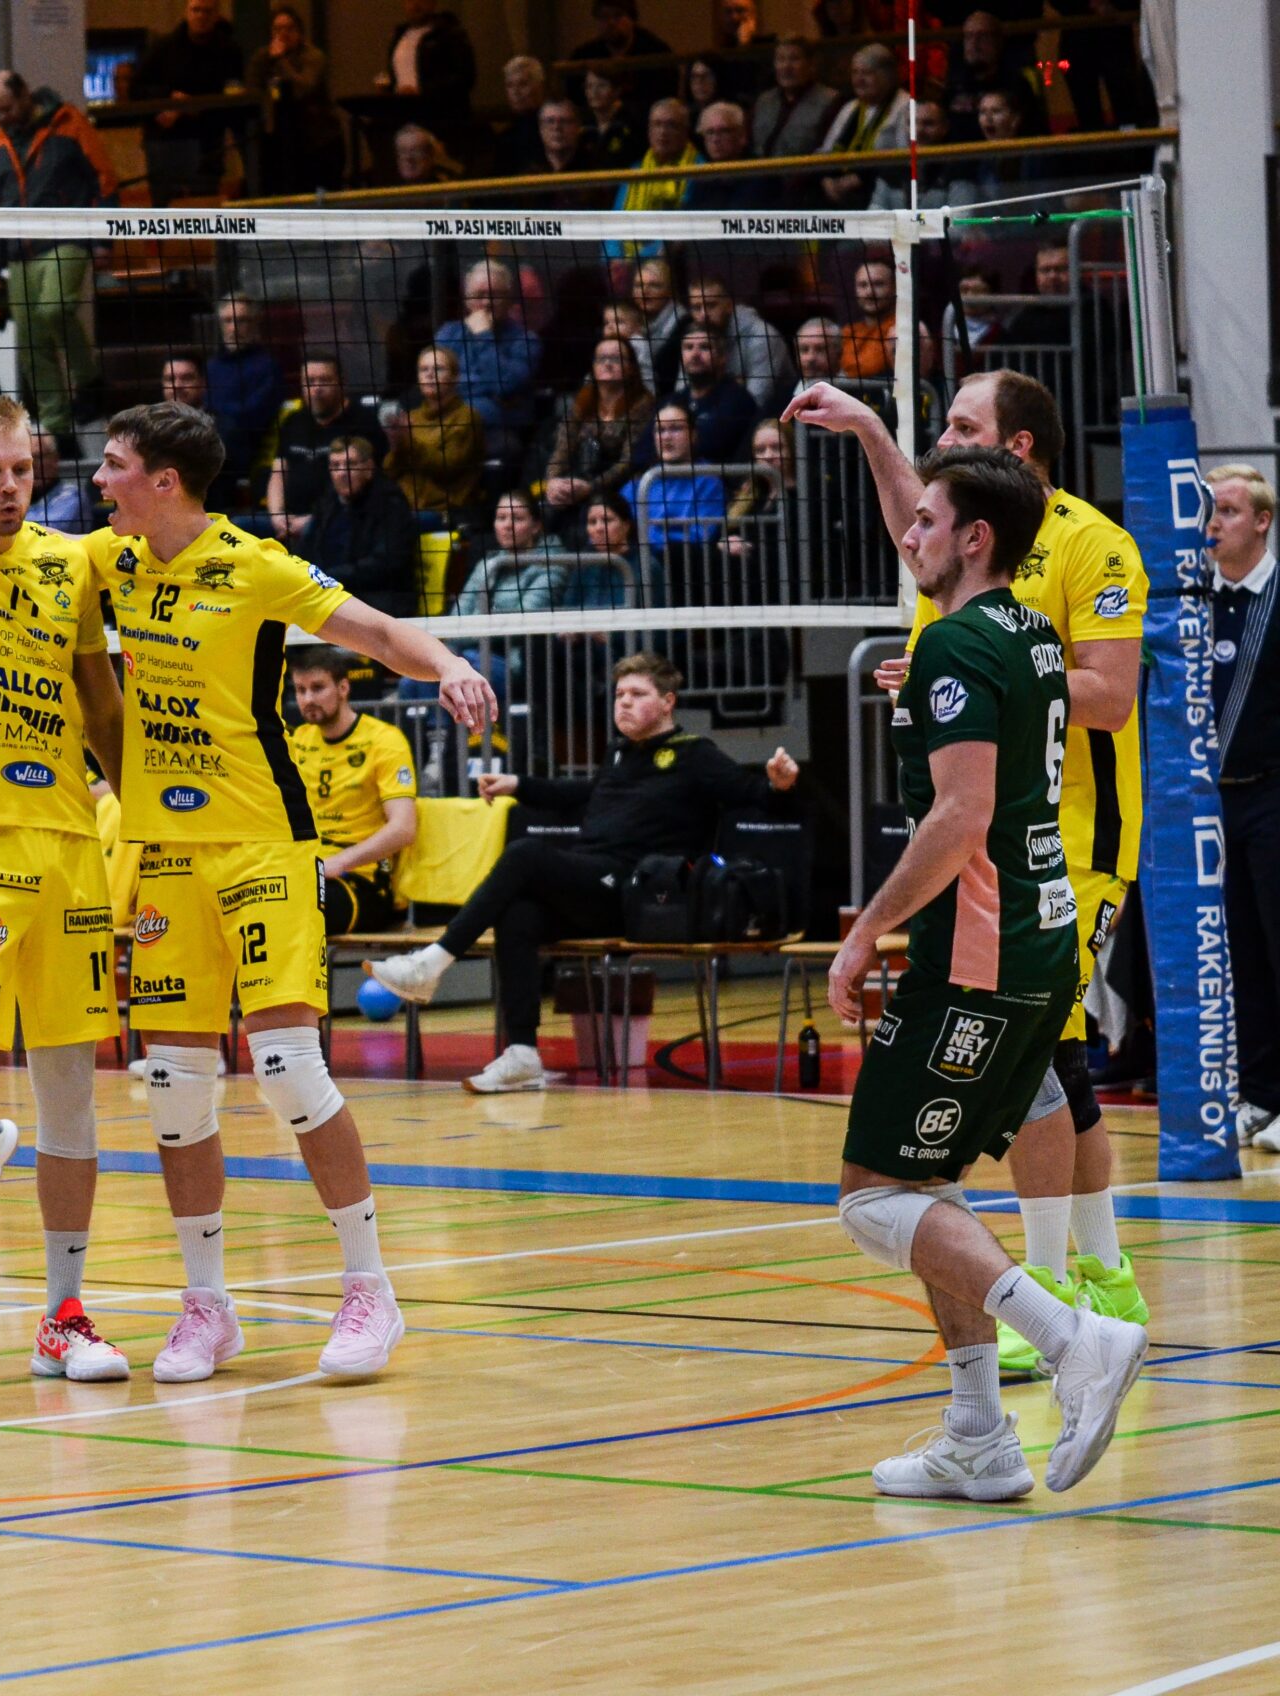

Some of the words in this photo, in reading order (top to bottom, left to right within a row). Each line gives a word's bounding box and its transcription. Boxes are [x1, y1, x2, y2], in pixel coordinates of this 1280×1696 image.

[106, 220, 136, 236] TMI.
[138, 219, 171, 235] PASI
[173, 215, 256, 235] MERILÄINEN
[426, 220, 453, 235] TMI.
[455, 220, 484, 235] PASI
[487, 217, 562, 236] MERILÄINEN
[721, 218, 746, 234] TMI.
[748, 219, 775, 234] PASI
[777, 215, 845, 234] MERILÄINEN
[219, 531, 242, 548] OK
[1108, 556, 1122, 567] BE
[150, 583, 181, 623] 12
[0, 630, 14, 641] OP
[53, 633, 68, 649] Oy
[182, 637, 200, 651] Oy
[0, 646, 14, 657] OP
[136, 652, 146, 664] OP
[148, 656, 193, 673] Harjuseutu
[136, 669, 146, 681] OP
[147, 672, 206, 689] Lounais-Suomi
[15, 765, 48, 782] WILLE
[318, 770, 332, 798] 8
[169, 790, 195, 806] WILLE
[175, 857, 192, 867] OY
[24, 875, 42, 885] OY
[269, 883, 282, 894] OY
[239, 922, 267, 965] 12
[134, 975, 185, 993] Rauta
[240, 979, 264, 989] CRAFT
[1196, 905, 1222, 1092] RAKENNUS
[954, 1016, 985, 1034] HO
[949, 1033, 990, 1051] NEY
[943, 1046, 981, 1066] STY
[265, 1065, 286, 1076] errea
[151, 1081, 171, 1089] errea
[920, 1108, 957, 1133] BE
[1200, 1102, 1226, 1148] OY
[899, 1144, 916, 1159] BE
[917, 1148, 950, 1160] GROUP
